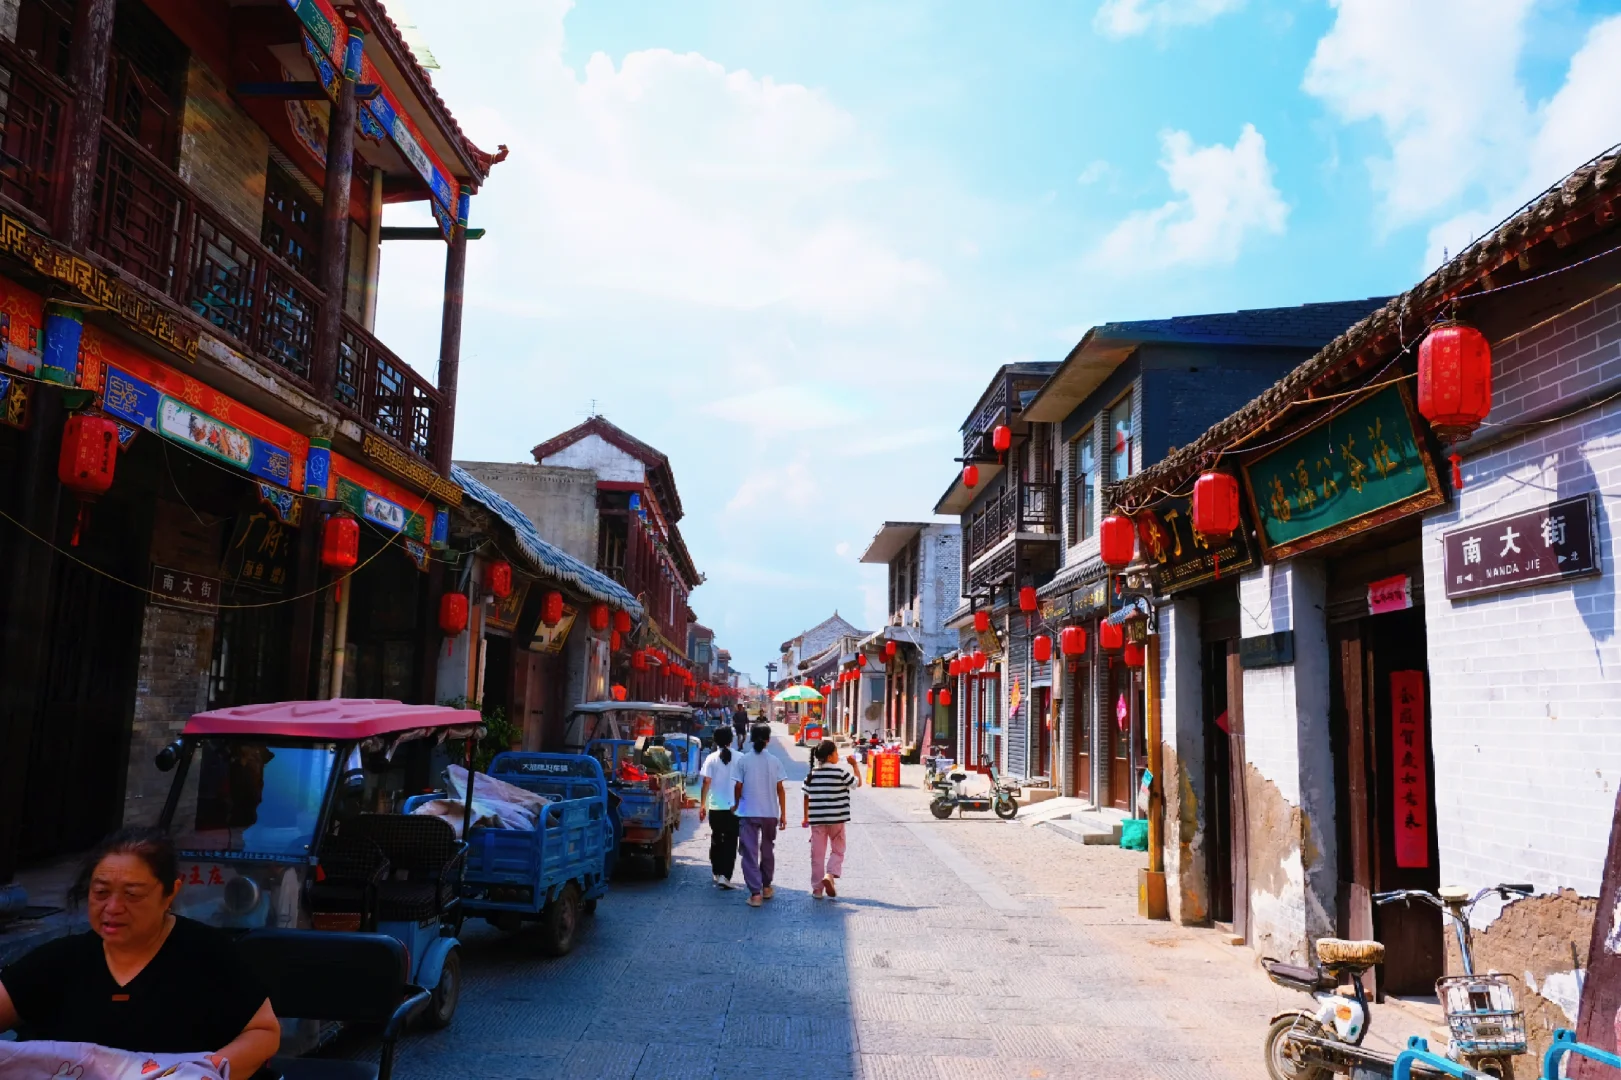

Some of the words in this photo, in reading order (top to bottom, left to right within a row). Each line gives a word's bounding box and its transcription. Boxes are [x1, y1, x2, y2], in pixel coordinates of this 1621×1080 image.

[235, 511, 288, 558] 广府
[1462, 514, 1567, 566] 南大街
[1486, 562, 1520, 579] NANDA
[1525, 558, 1541, 572] JIE
[1570, 551, 1580, 562] 北
[162, 573, 212, 598] 南大街
